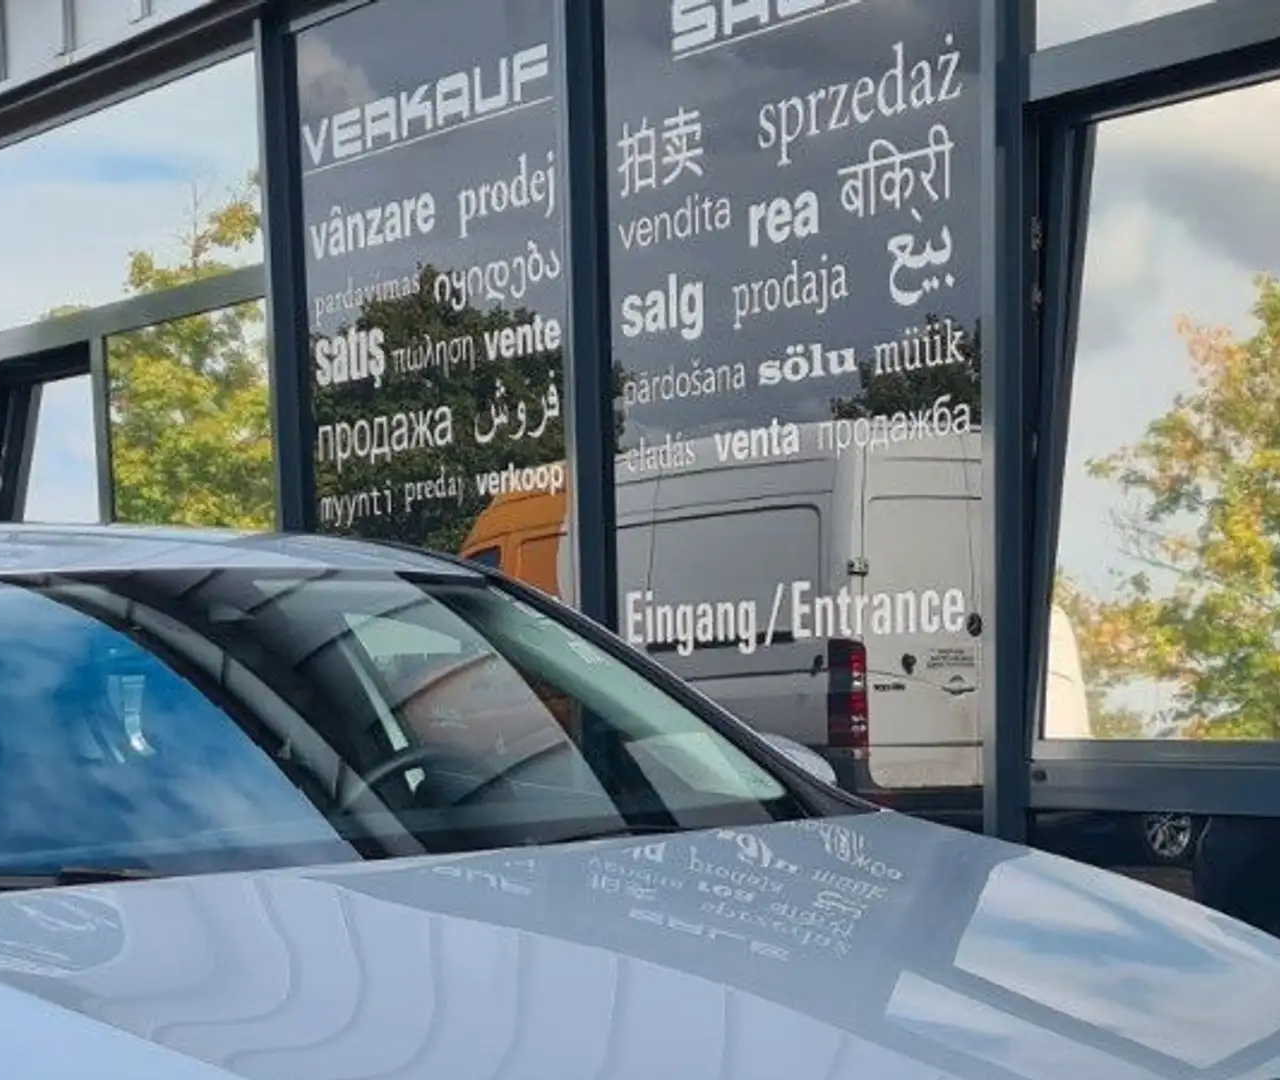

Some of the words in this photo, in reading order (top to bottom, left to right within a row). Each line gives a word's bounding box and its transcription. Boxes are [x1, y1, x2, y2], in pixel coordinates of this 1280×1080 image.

[672, 0, 825, 51] SA
[303, 43, 548, 166] VERKAUF
[757, 33, 963, 167] sprzedaż
[617, 106, 704, 198] 拍卖
[310, 192, 436, 260] vânzare
[458, 150, 555, 239] prodej
[618, 194, 731, 250] vendita
[748, 190, 819, 247] rea
[621, 273, 704, 340] salg
[732, 253, 849, 330] prodaja
[483, 313, 561, 361] vente
[758, 343, 858, 387] sölu
[873, 319, 966, 376] müük
[318, 405, 453, 471] продажа
[714, 417, 800, 462] venta
[818, 394, 970, 460] продажба
[320, 480, 392, 527] myynti
[404, 465, 464, 513] predaj
[476, 461, 563, 495] verkoop
